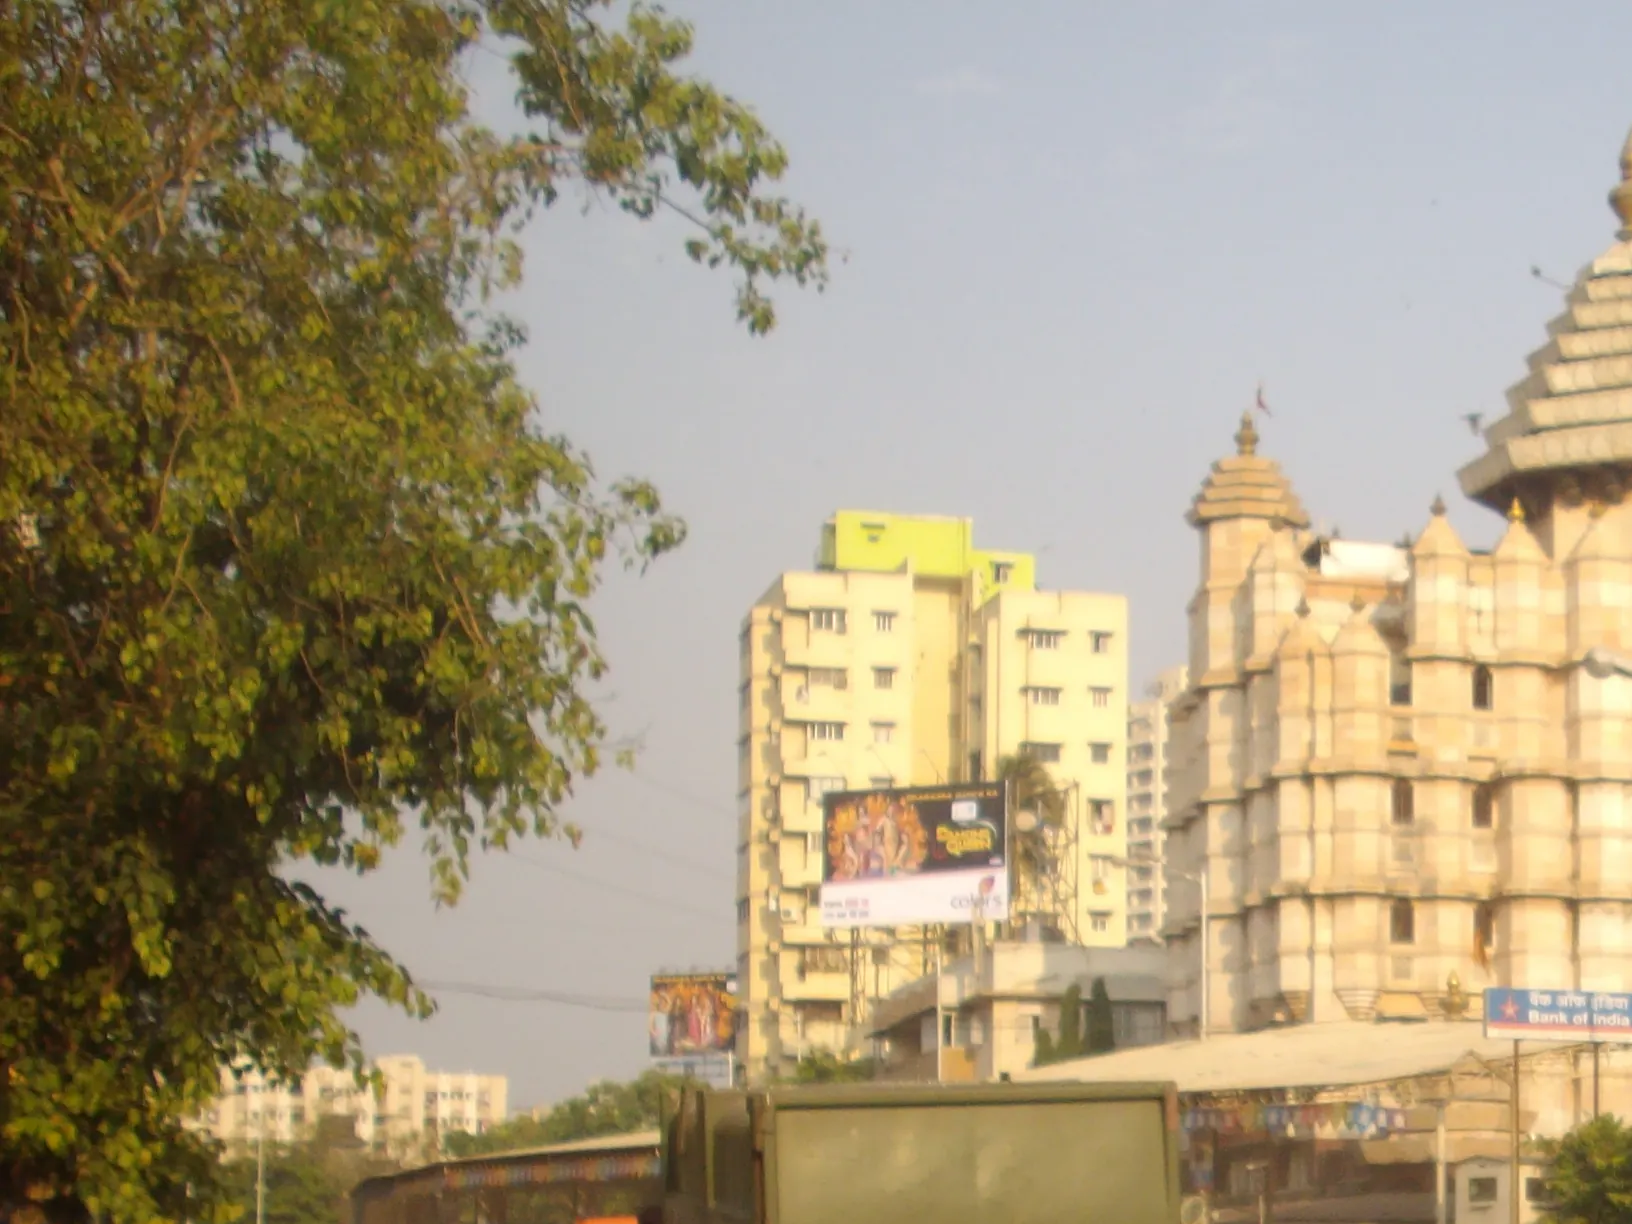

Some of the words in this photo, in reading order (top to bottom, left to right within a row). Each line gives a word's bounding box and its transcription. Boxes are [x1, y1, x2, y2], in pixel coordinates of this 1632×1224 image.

[1528, 1009, 1568, 1024] Bank
[1572, 1011, 1588, 1025] of
[1593, 1012, 1631, 1026] India
